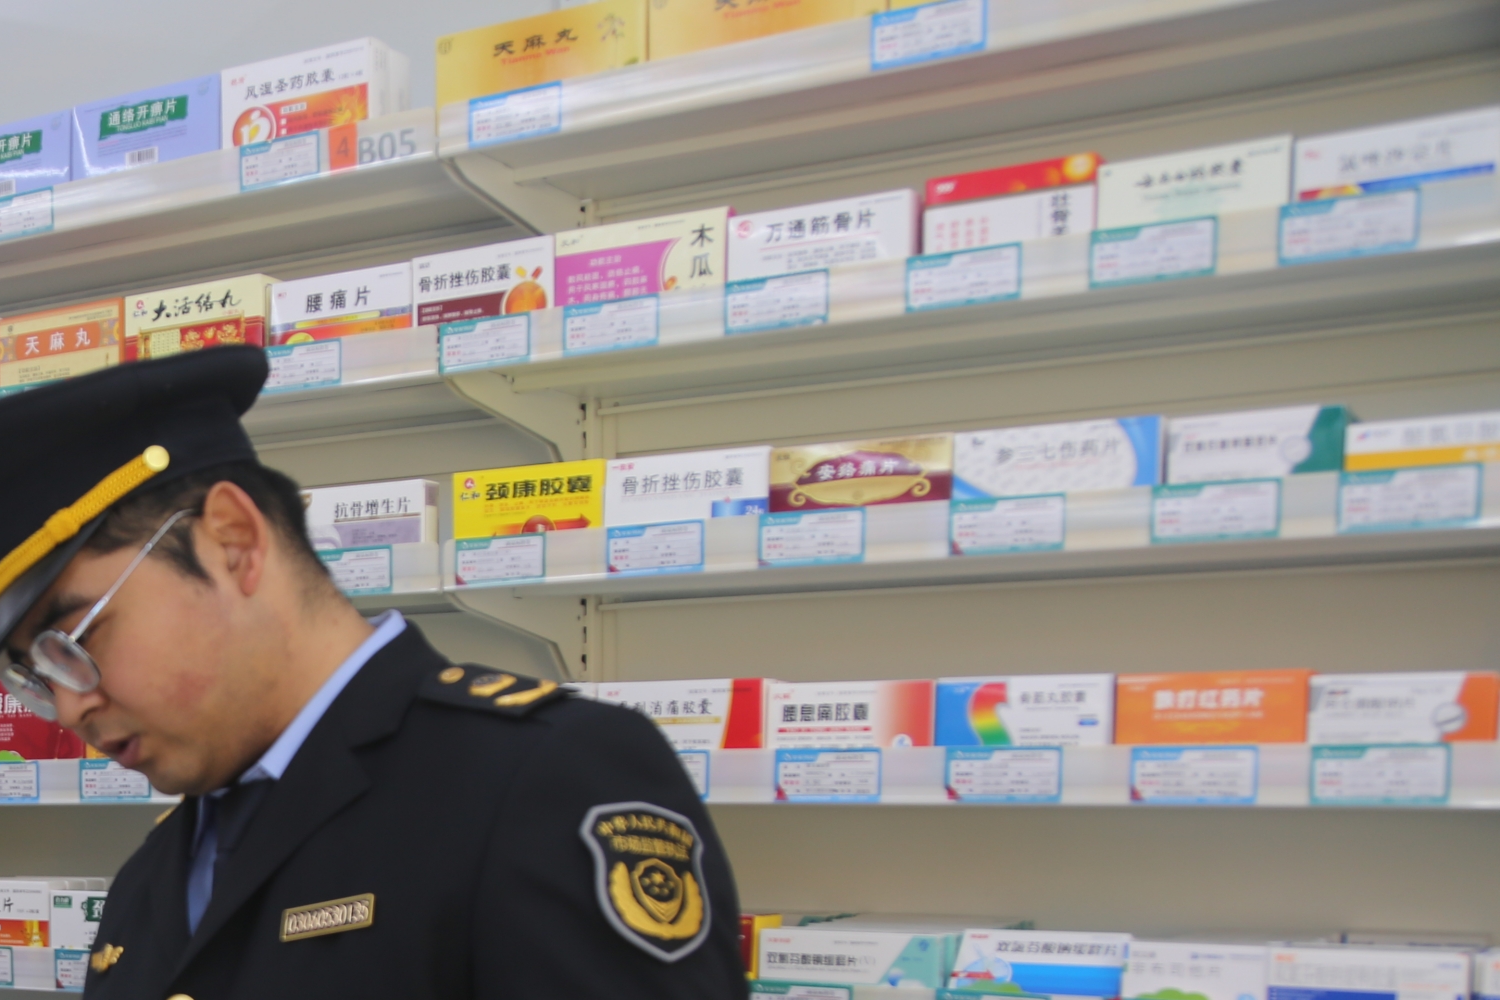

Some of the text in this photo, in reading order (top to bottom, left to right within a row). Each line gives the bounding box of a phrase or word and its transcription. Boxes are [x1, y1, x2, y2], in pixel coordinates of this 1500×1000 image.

[493, 28, 578, 57] 天麻丸
[245, 67, 336, 100] 风湿圣药胶囊
[108, 98, 178, 127] 通络开痹片
[358, 129, 416, 165] B05
[765, 208, 876, 243] 万通筋骨片
[419, 263, 511, 293] 骨折挫伤胶囊
[306, 287, 371, 313] 腰痛片
[25, 328, 91, 355] 天麻丸
[485, 474, 593, 501] 颈康胶囊
[622, 466, 744, 495] 骨折挫伤胶囊
[333, 496, 412, 520] 抗骨增生片
